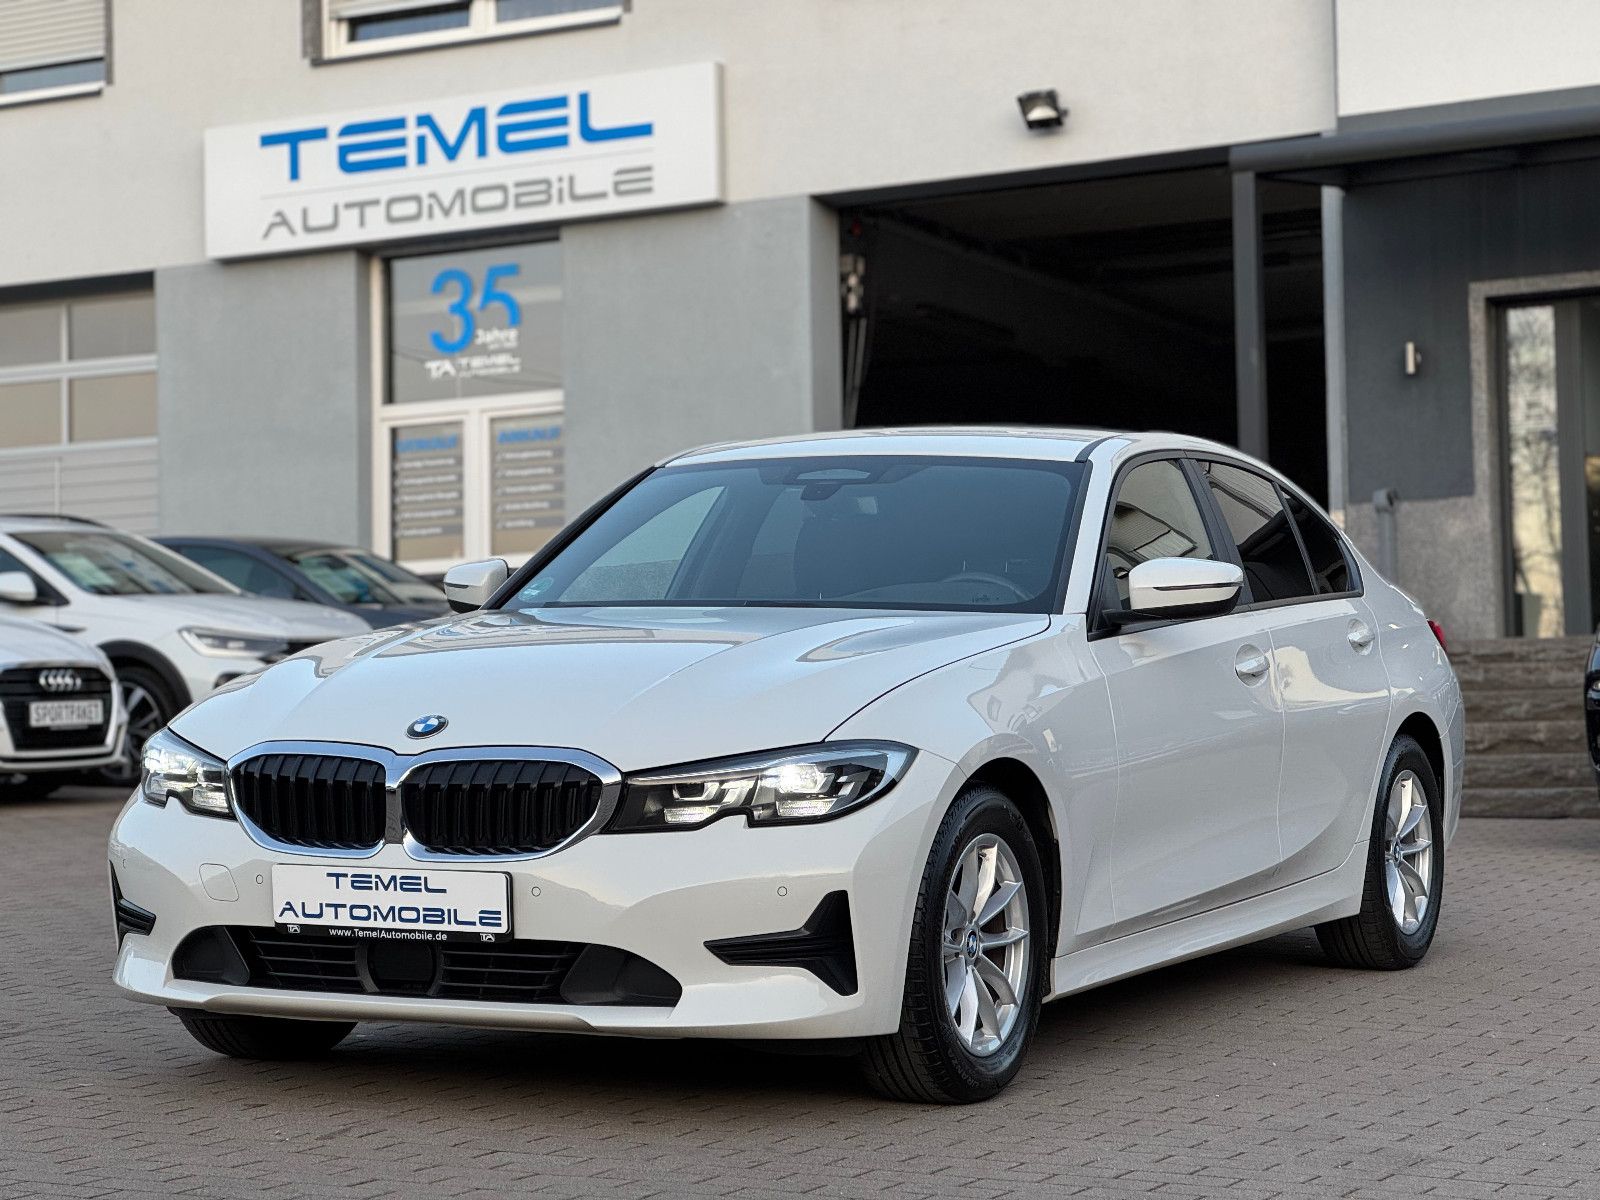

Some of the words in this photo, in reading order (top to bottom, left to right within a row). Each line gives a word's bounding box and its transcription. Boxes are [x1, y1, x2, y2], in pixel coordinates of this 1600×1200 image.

[261, 91, 653, 181] TEMEL
[430, 263, 521, 355] 35
[326, 872, 447, 893] TEMEL
[279, 900, 502, 927] AUTOMOBILE
[329, 927, 448, 941] www.TemelAutomobile.de
